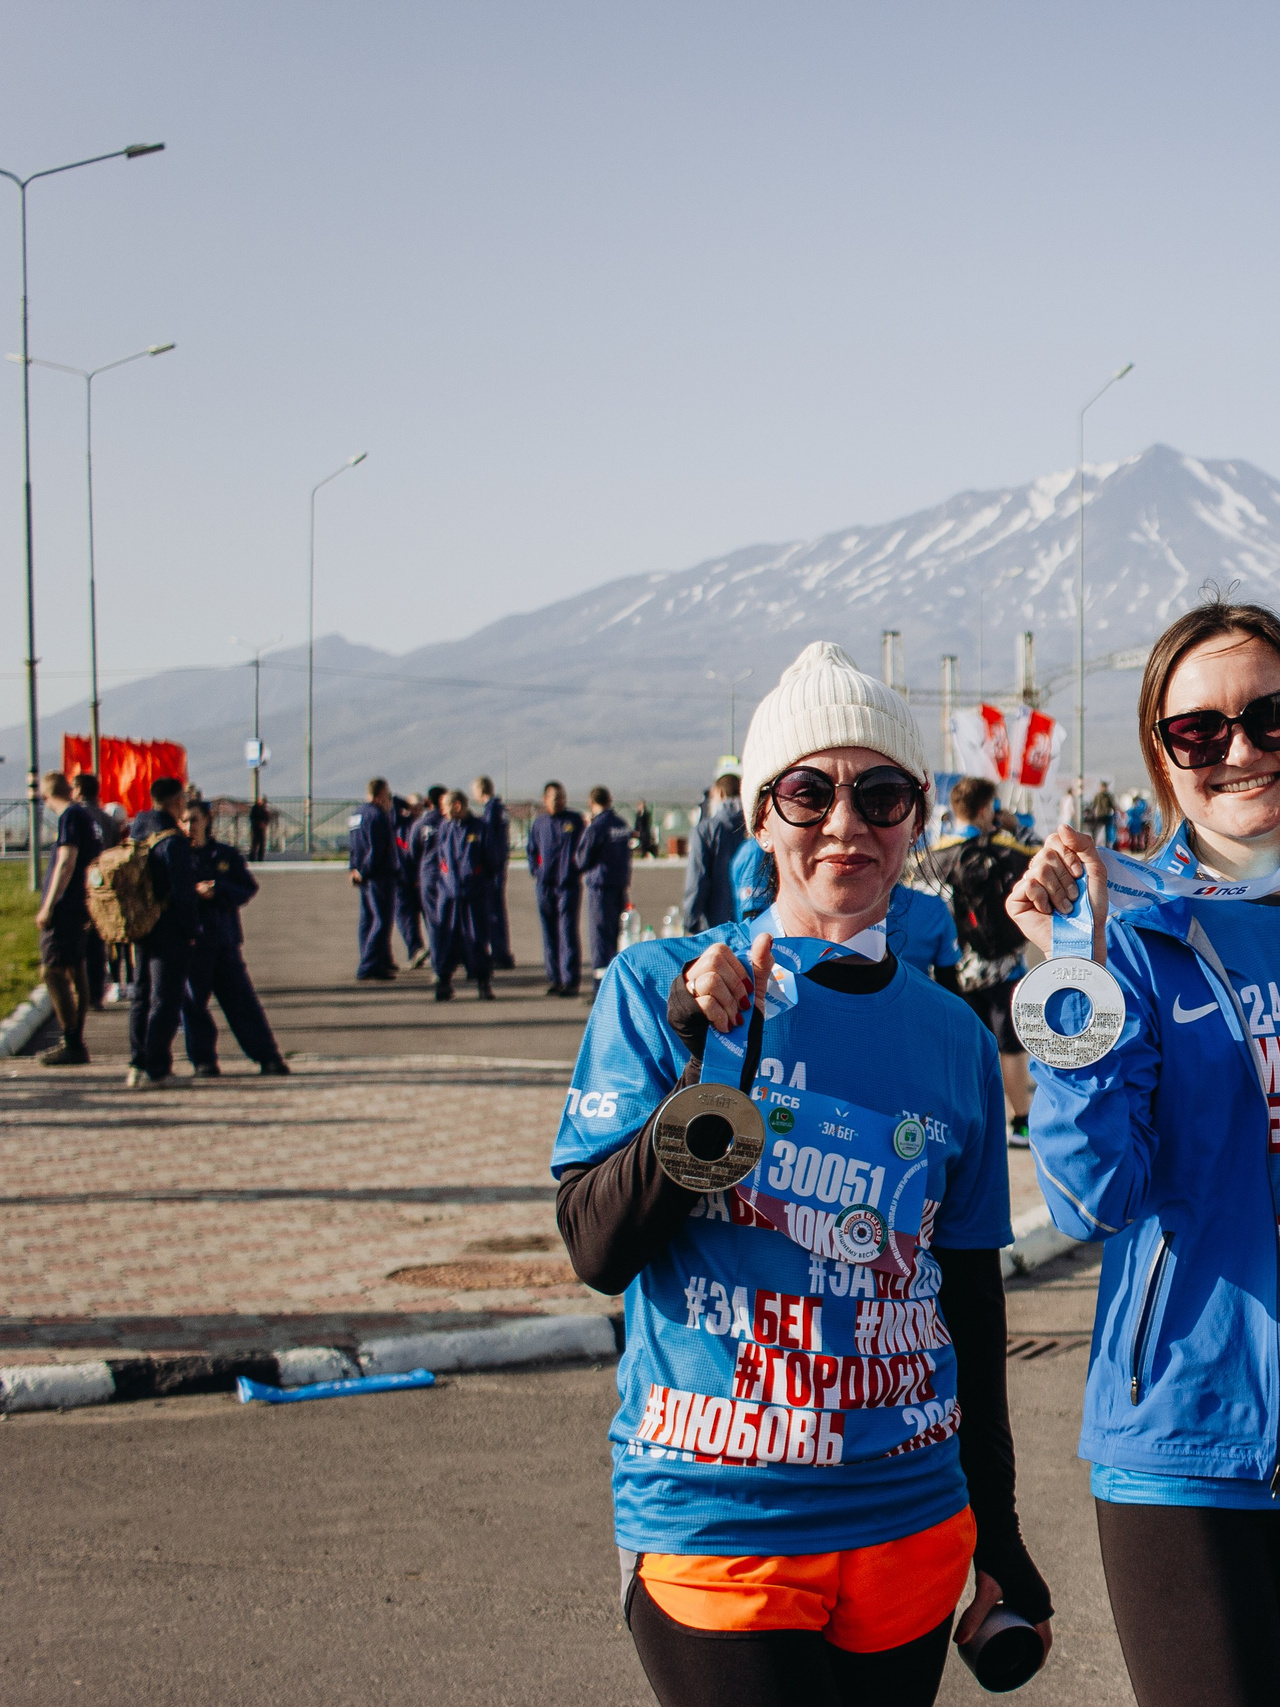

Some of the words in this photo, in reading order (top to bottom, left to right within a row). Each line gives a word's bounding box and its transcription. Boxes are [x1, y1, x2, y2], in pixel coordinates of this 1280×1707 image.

[1214, 885, 1251, 896] ПСБ
[770, 1091, 801, 1110] ПСБ
[767, 1139, 886, 1209] 30051
[838, 1228, 858, 1257] ЛИШНЕМУ
[866, 1212, 882, 1242] ВЫЗОВ
[684, 1276, 823, 1352] #ЗАБЕГ
[733, 1341, 938, 1410] #ГОРДОСТЬ
[635, 1383, 845, 1465] #ЛЮБОВЬ
